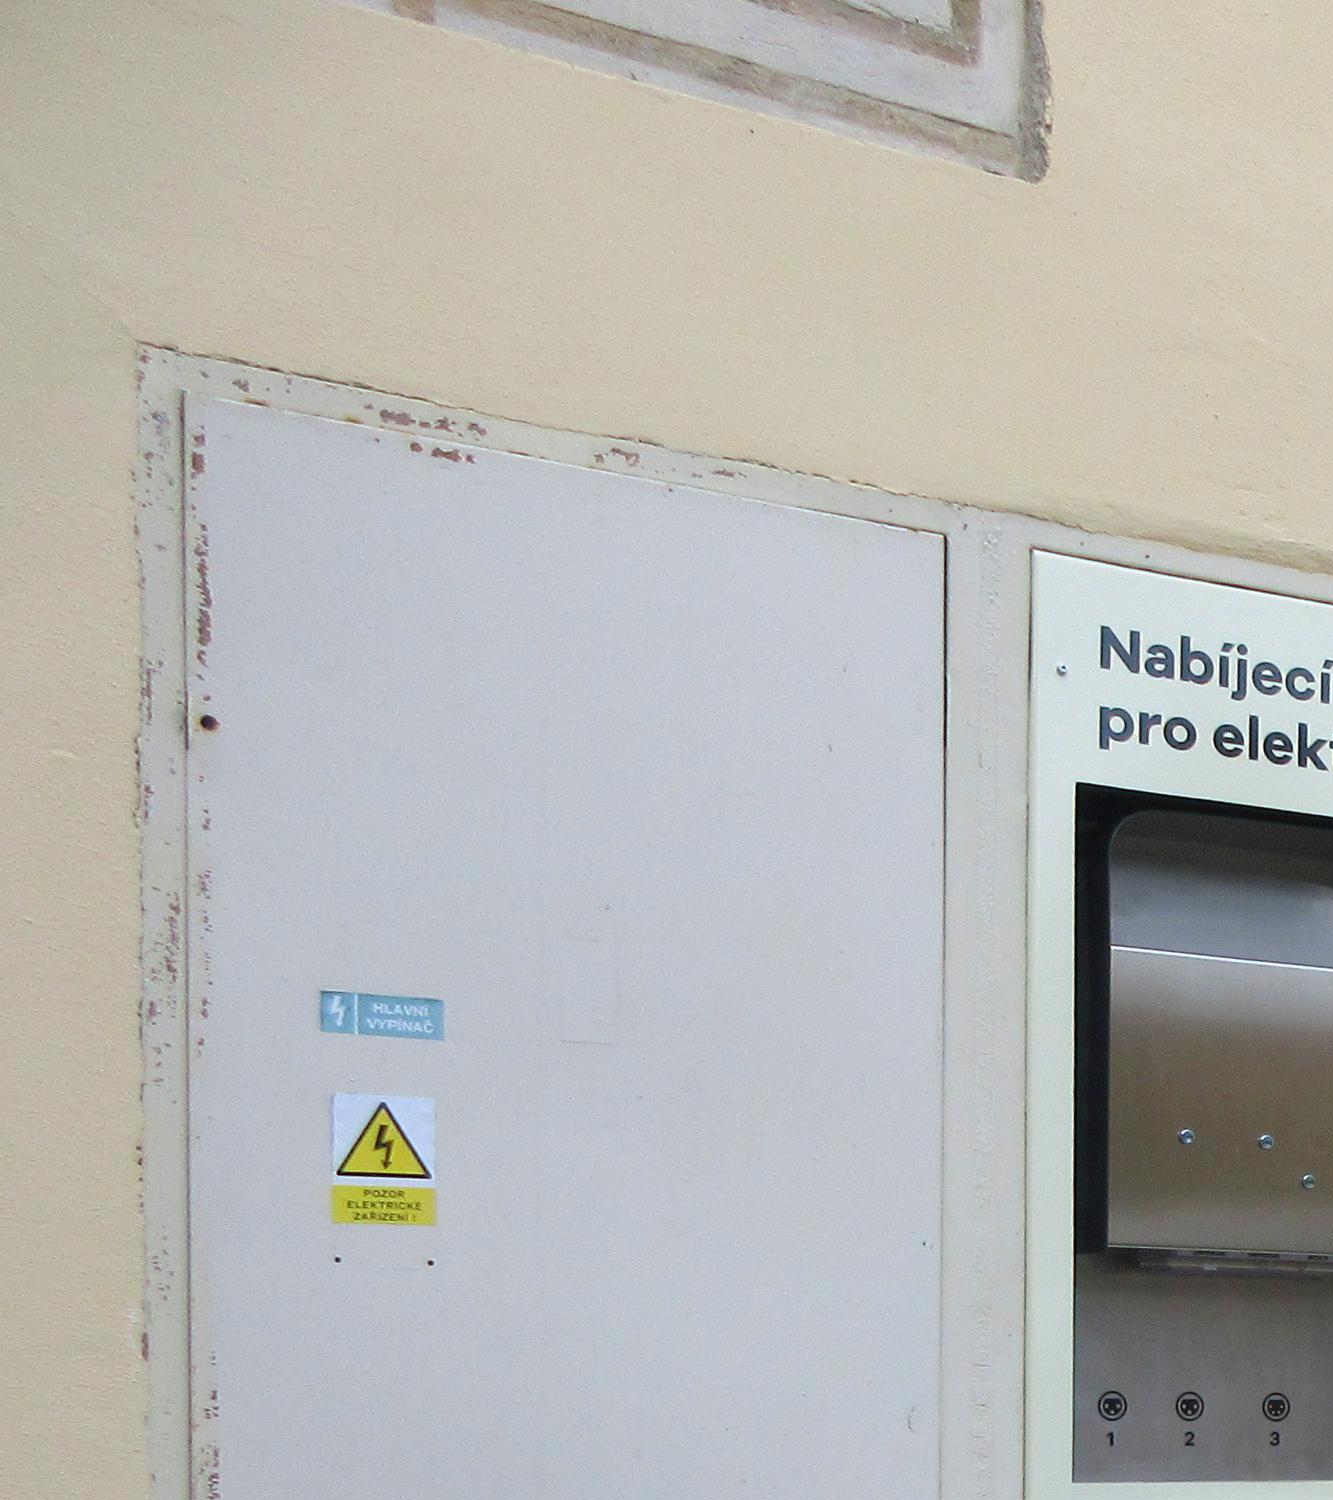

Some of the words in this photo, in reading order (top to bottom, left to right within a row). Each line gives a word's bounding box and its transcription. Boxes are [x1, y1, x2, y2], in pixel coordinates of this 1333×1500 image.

[1099, 704, 1198, 751] pro
[373, 1002, 428, 1017] HLAVNÍ
[367, 1017, 434, 1033] VYPÍNAČ
[363, 1189, 405, 1199] POZOR
[1106, 1432, 1115, 1446] 1
[1185, 1432, 1195, 1446] 2
[1269, 1432, 1280, 1446] 3
